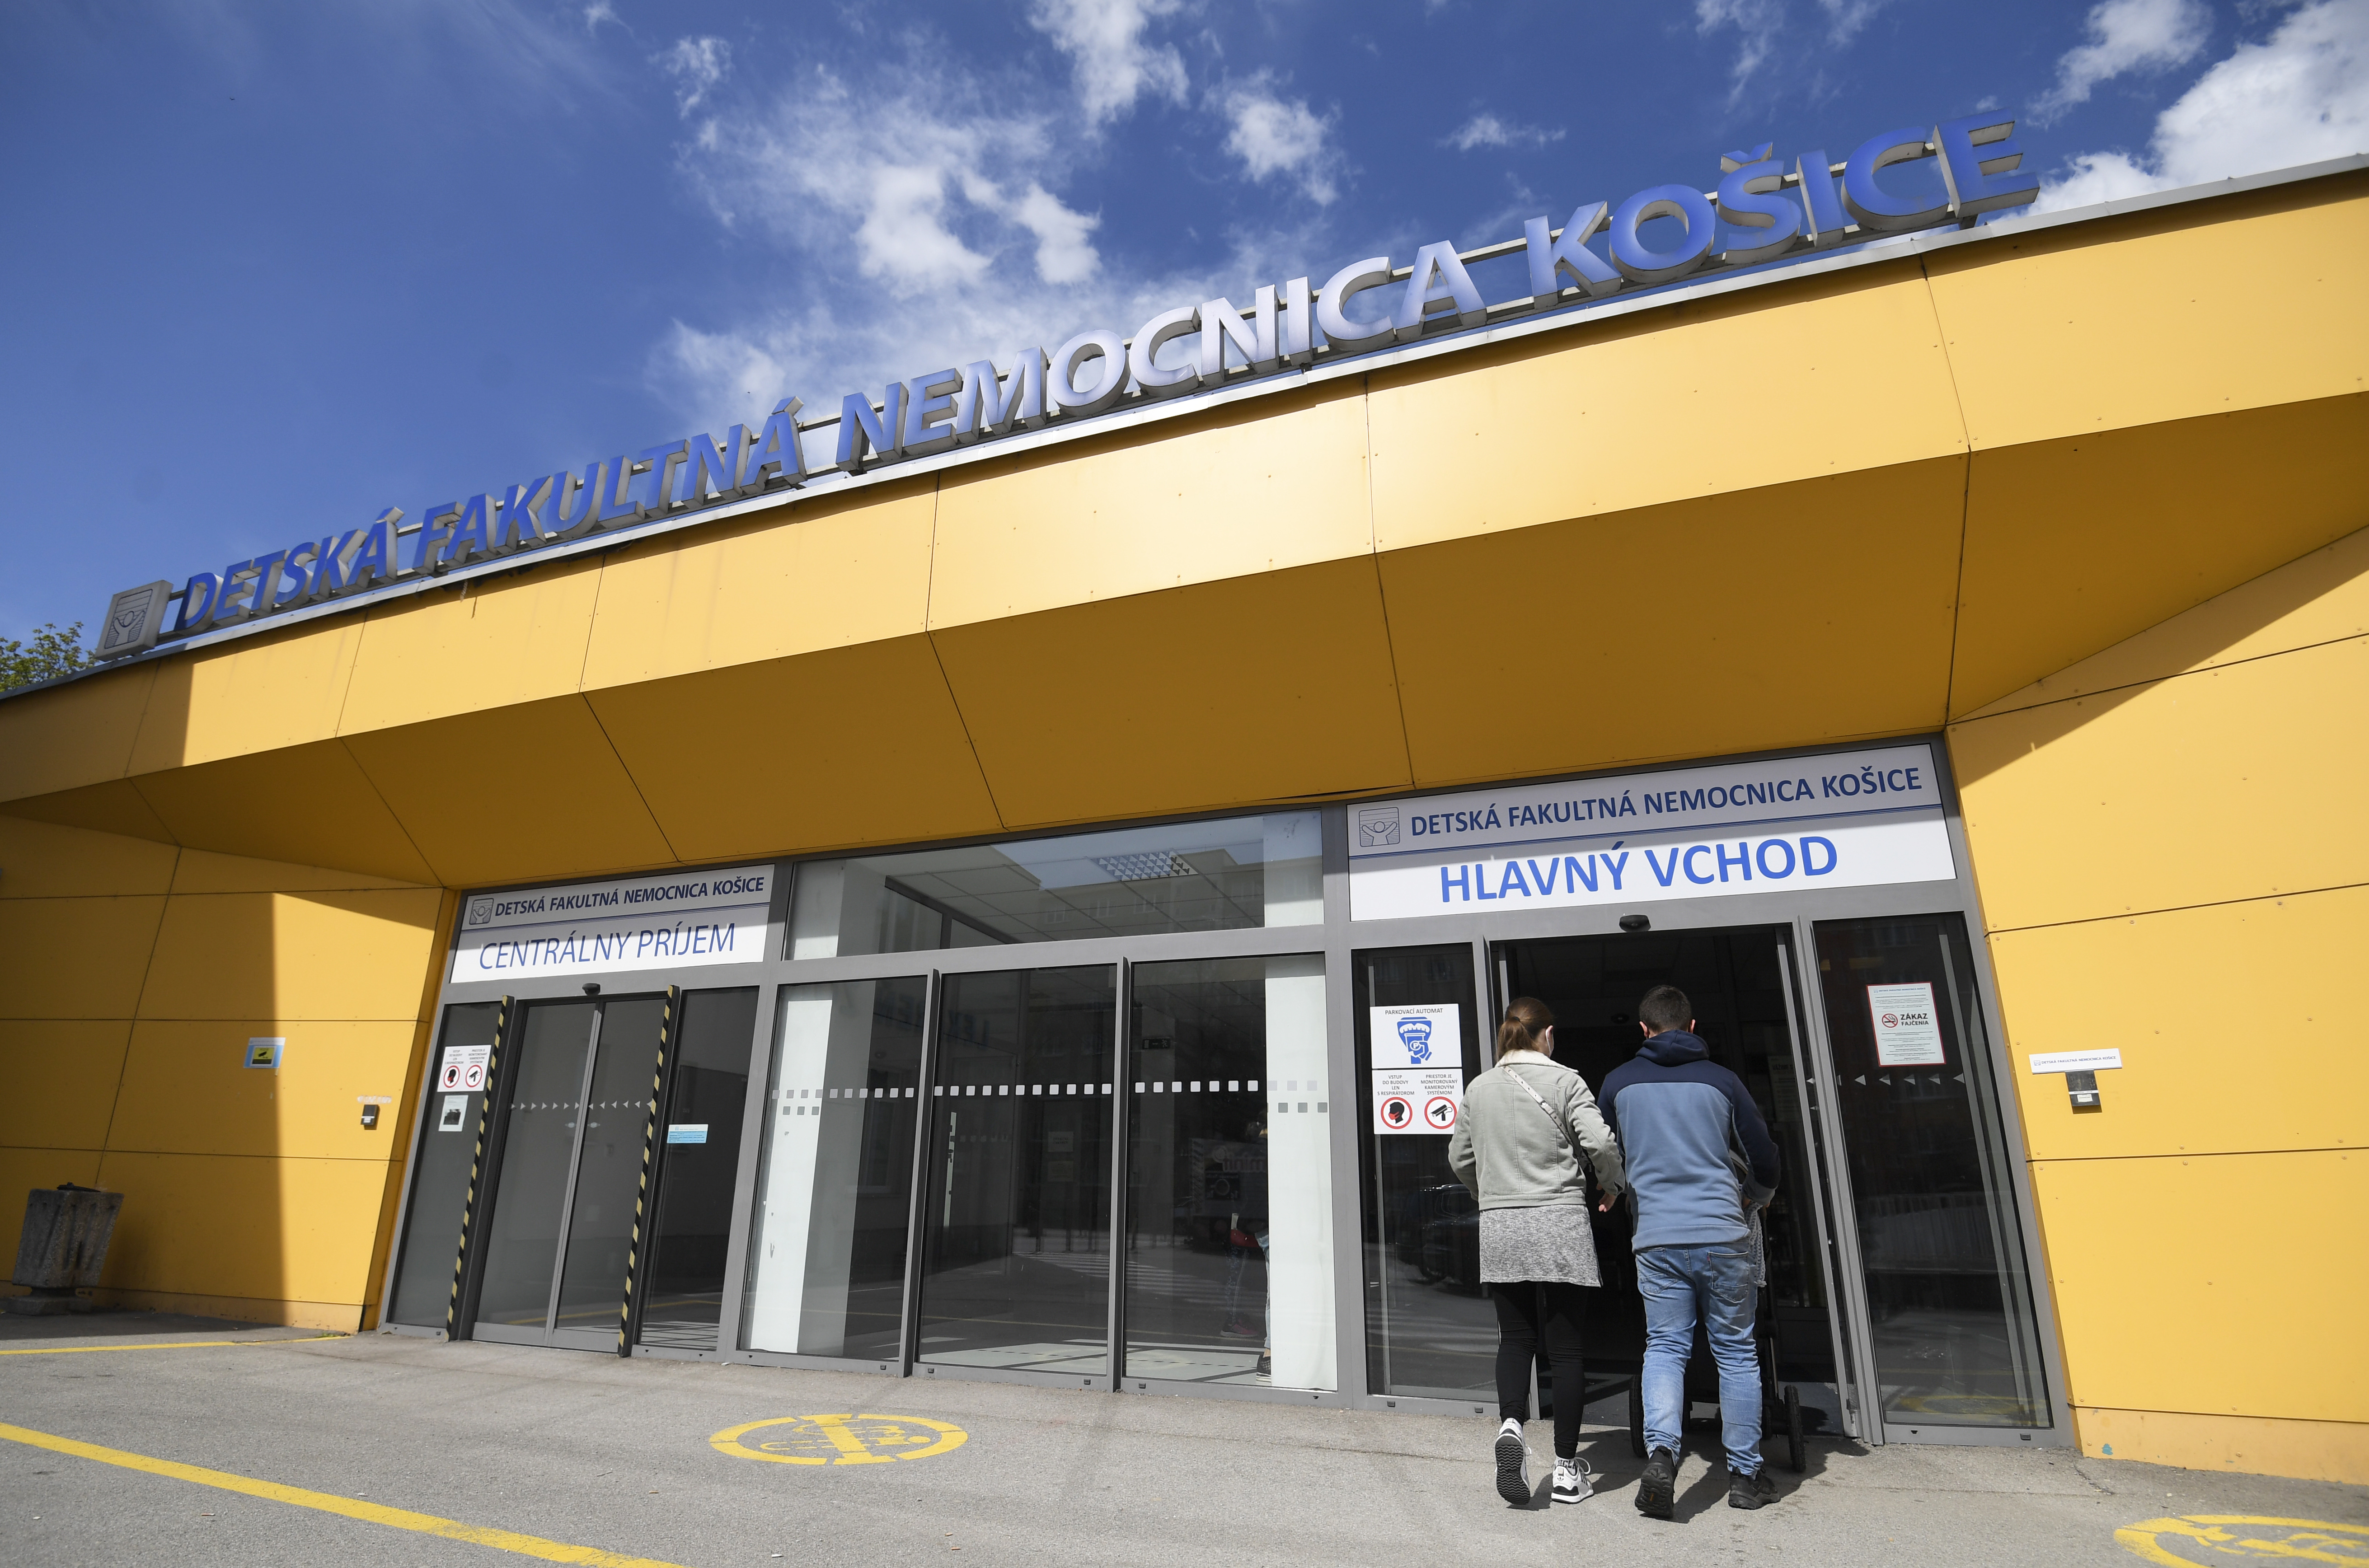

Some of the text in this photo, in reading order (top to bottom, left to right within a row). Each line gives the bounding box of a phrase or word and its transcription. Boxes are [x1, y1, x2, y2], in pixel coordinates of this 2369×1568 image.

[174, 108, 2040, 632] DETSKÁ FAKULTNÁ NEMOCNICA KOŠICE
[1412, 765, 1922, 837] DETSKÁ FAKULTNÁ NEMOCNICA KOŠICE
[495, 876, 765, 916] DETSKÁ FAKULTNÁ NEMOCNICA KOŠICE
[1440, 834, 1838, 903] HLAVNÝ VCHOD
[479, 921, 736, 969] CENTRÁLNY PRÍJEM
